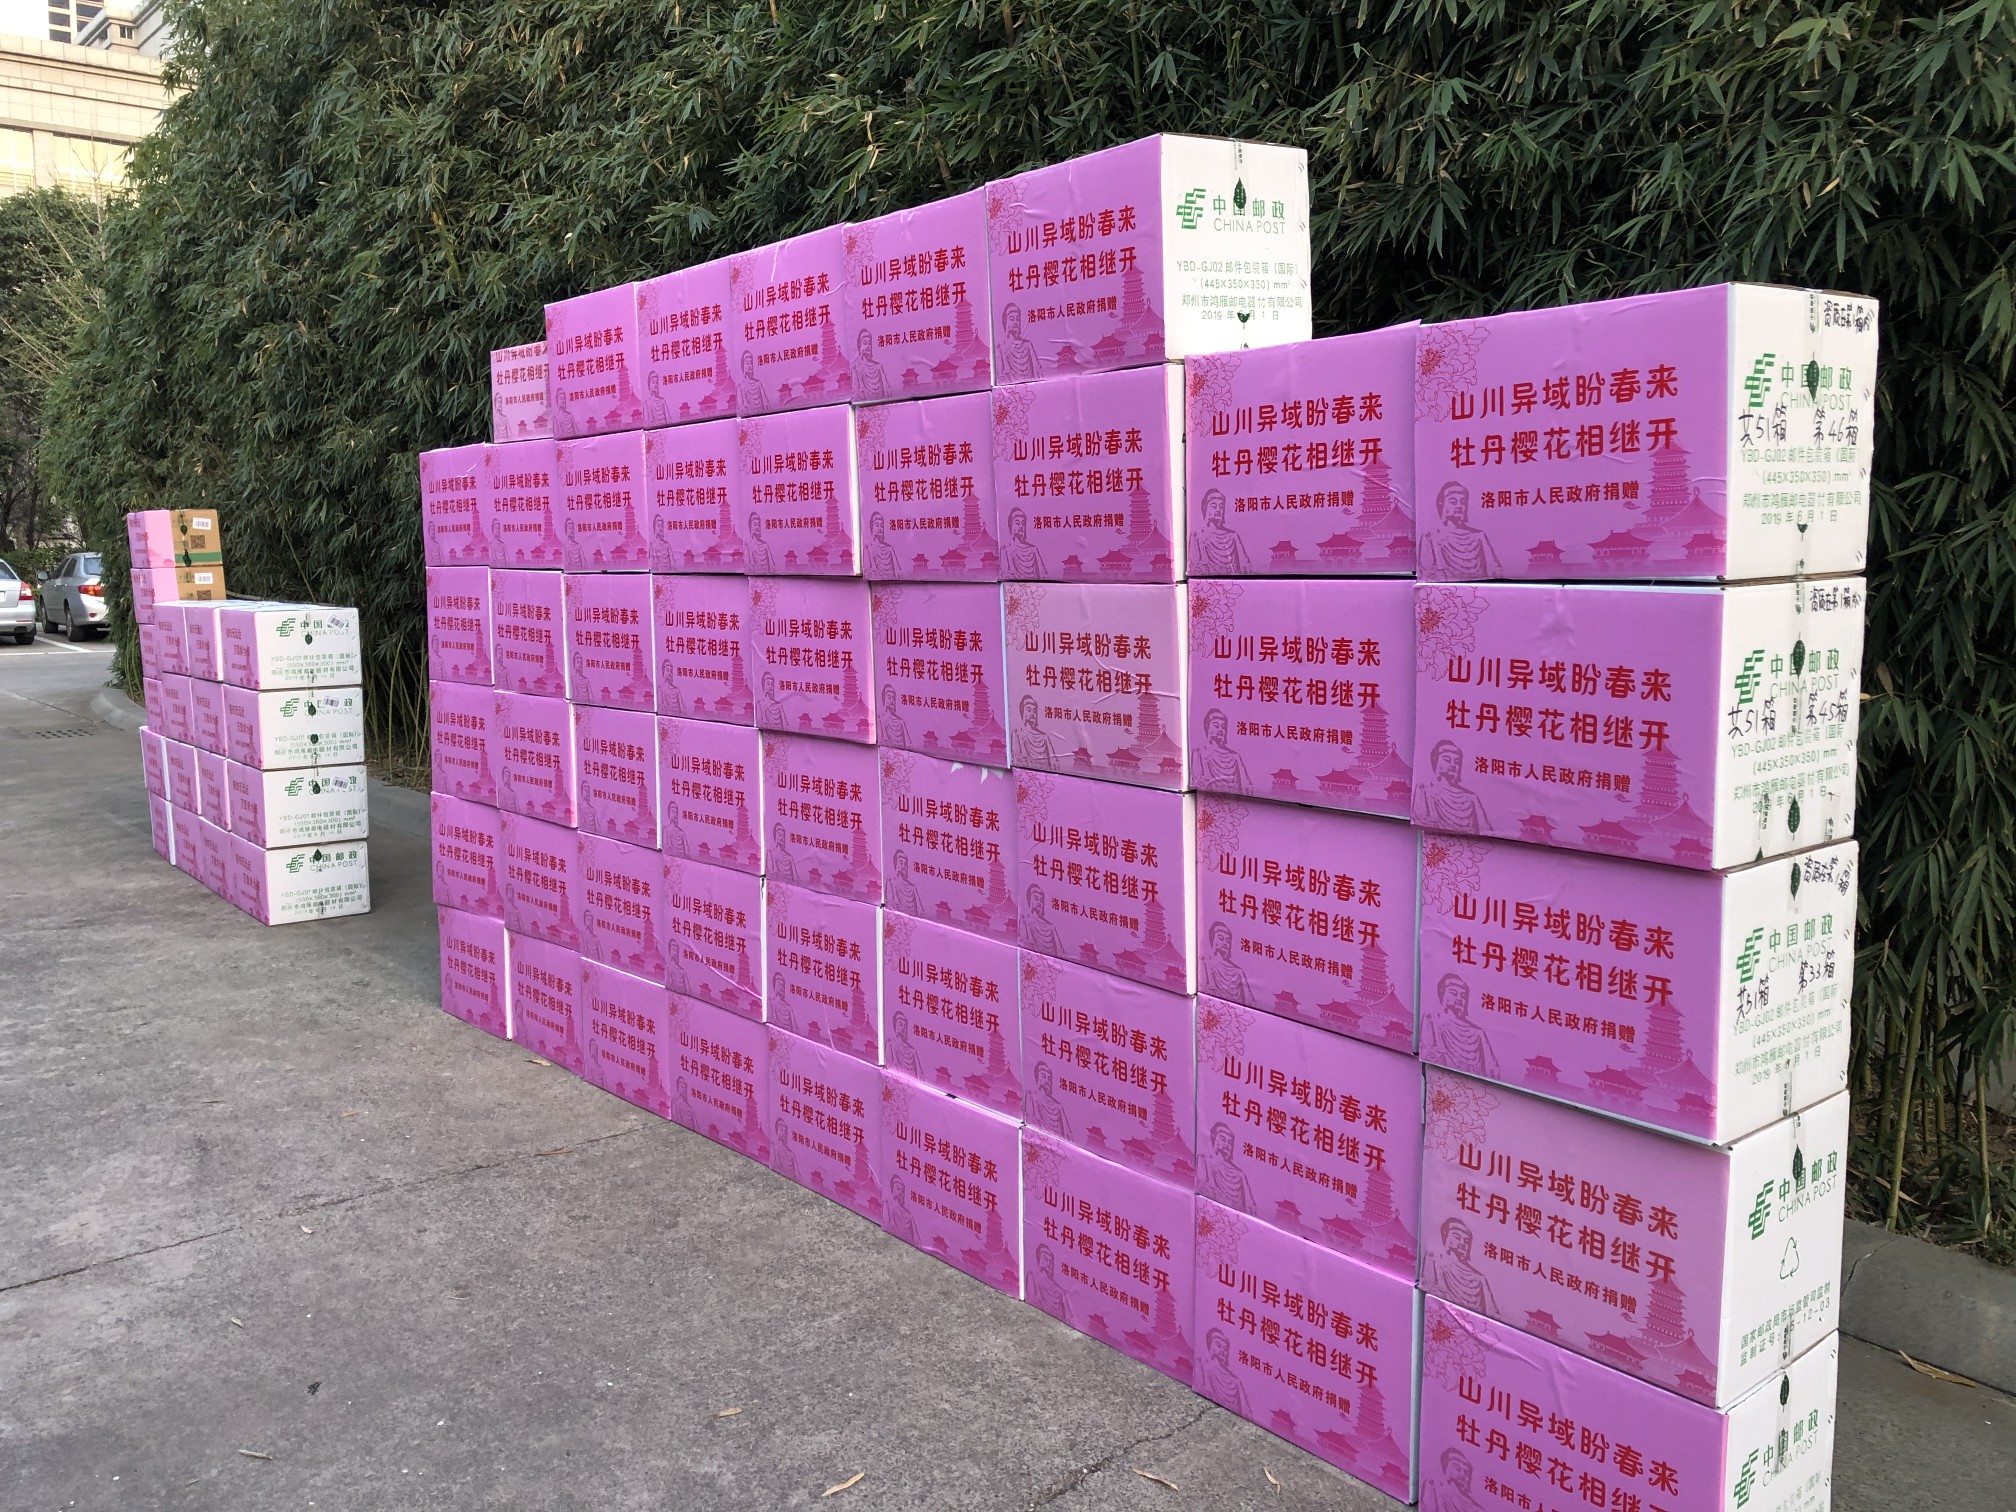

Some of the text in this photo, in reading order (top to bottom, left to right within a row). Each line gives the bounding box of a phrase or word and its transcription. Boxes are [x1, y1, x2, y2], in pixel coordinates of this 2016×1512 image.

[1008, 205, 1135, 254] 山川异域盼春来
[1214, 218, 1285, 234] CHINA POST
[861, 245, 965, 285] 山川异域盼春来
[1009, 245, 1136, 291] 牡丹樱花相继开
[1177, 261, 1222, 272] YBD-GJ02
[743, 271, 829, 311] 山川异域盼春来
[862, 281, 966, 319] 牡丹樱花相继开
[1027, 295, 1116, 323] 洛阳市人民政府捐赠
[650, 303, 721, 335] 山川异域盼春来
[744, 303, 830, 341] 牡丹樱花相继开
[556, 326, 623, 355] 山川异域盼春来
[651, 332, 722, 362] 牡丹樱花相继开
[1452, 364, 1677, 420] 山川异域盼春来
[1781, 392, 1852, 410] CHINA POST
[1212, 391, 1382, 435] 山川异域盼春来
[751, 449, 833, 474] 山川异域盼春来
[873, 441, 972, 470] 山川异域盼春来
[1014, 427, 1142, 460] 山川异域盼春来
[1212, 437, 1382, 477] 牡丹樱花相继开
[1451, 417, 1677, 468] 牡丹樱花相继开
[566, 464, 629, 486] 山川异域盼春来
[656, 458, 725, 480] 山川异域盼春来
[1015, 467, 1143, 497] 牡丹樱花相继开
[752, 480, 834, 503] 牡丹樱花相继开
[875, 476, 973, 502] 牡丹樱花相继开
[1234, 490, 1354, 512] 洛阳市人民政府捐赠
[1481, 479, 1639, 508] 洛阳市人民政府捐赠
[765, 516, 822, 529] 洛阳市人民政府捐赠
[889, 516, 959, 530] 洛阳市人民政府捐赠
[1033, 512, 1124, 529] 洛阳市人民政府捐赠
[665, 610, 739, 630] 山川异域盼春来
[765, 618, 852, 639] 山川异域盼春来
[886, 626, 982, 651] 山川异域盼春来
[766, 646, 852, 668] 牡丹樱花相继开
[1025, 631, 1150, 659] 山川异域盼春来
[1215, 635, 1380, 666] 山川异域盼春来
[779, 680, 839, 695] 洛阳市人民政府捐赠
[887, 656, 983, 683] 牡丹樱花相继开
[1026, 664, 1151, 695] 牡丹樱花相继开
[1449, 655, 1671, 702] 山川异域盼春来
[1771, 674, 1839, 699] CHINA POST
[901, 694, 969, 712] 洛阳市人民政府捐赠
[1214, 673, 1380, 708] 牡丹樱花相继开
[1044, 706, 1132, 727] 洛阳市人民政府捐赠
[1236, 721, 1352, 745] 洛阳市人民政府捐赠
[1446, 699, 1669, 750] 牡丹樱花相继开
[671, 753, 744, 781] 山川异域盼春来
[1474, 757, 1630, 792] 洛阳市人民政府捐赠
[778, 771, 861, 802] 山川异域盼春来
[778, 798, 861, 830] 牡丹樱花相继开
[898, 794, 999, 831] 山川异域盼春来
[790, 833, 848, 854] 洛阳市人民政府捐赠
[899, 823, 999, 862] 牡丹樱花相继开
[1033, 822, 1157, 868] 山川异域盼春来
[338, 860, 357, 868] POST
[913, 861, 984, 889] 洛阳市人民政府捐赠
[1033, 854, 1158, 902] 牡丹樱花相继开
[1220, 852, 1380, 908] 山川异域盼春来
[672, 892, 745, 928] 山川异域盼春来
[1051, 898, 1138, 931] 洛阳市人民政府捐赠
[1219, 888, 1380, 947] 牡丹樱花相继开
[1455, 892, 1674, 960] 山川异域盼春来
[777, 921, 860, 961] 山川异域盼春来
[1769, 913, 1832, 953] 中国邮政
[778, 948, 860, 989] 牡丹樱花相继开
[1240, 938, 1352, 979] 洛阳市人民政府捐赠
[1452, 935, 1673, 1006] 牡丹樱花相继开
[1769, 937, 1832, 972] CHINA POST
[789, 984, 847, 1011] 洛阳市人民政府捐赠
[899, 956, 998, 1003] 山川异域盼春来
[899, 985, 999, 1033] 牡丹樱花相继开
[1481, 994, 1635, 1043] 洛阳市人民政府捐赠
[913, 1024, 983, 1058] 洛阳市人民政府捐赠
[1041, 1001, 1167, 1061] 山川异域盼春来
[680, 1031, 753, 1074] 山川异域盼春来
[1041, 1033, 1167, 1095] 牡丹樱花相继开
[780, 1069, 863, 1118] 山川异域盼春来
[1059, 1078, 1147, 1121] 洛阳市人民政府捐赠
[1224, 1055, 1386, 1134] 山川异域盼春来
[780, 1094, 864, 1145] 牡丹樱花相继开
[1222, 1091, 1385, 1171] 牡丹樱花相继开
[792, 1131, 850, 1166] 洛阳市人民政府捐赠
[896, 1121, 997, 1183] 山川异域盼春来
[896, 1149, 997, 1212] 牡丹樱花相继开
[1243, 1142, 1357, 1199] 洛阳市人民政府捐赠
[1779, 1150, 1837, 1202] 中国邮政
[1459, 1143, 1678, 1241] 山川异域盼春来
[1779, 1174, 1837, 1222] CHINA POST
[910, 1191, 981, 1234] 洛阳市人民政府捐赠
[1044, 1186, 1169, 1260] 山川异域盼春来
[1456, 1182, 1676, 1283] 牡丹樱花相继开
[1044, 1217, 1169, 1293] 牡丹樱花相继开
[1061, 1263, 1149, 1316] 洛阳市人民政府捐赠
[1484, 1242, 1636, 1314] 洛阳市人民政府捐赠
[1219, 1263, 1377, 1352] 山川异域盼春来
[1217, 1297, 1377, 1389] 牡丹樱花相继开
[1238, 1350, 1350, 1415] 洛阳市人民政府捐赠
[1459, 1375, 1678, 1497] 山川异域盼春来
[1796, 1430, 1818, 1459] POST
[1456, 1414, 1676, 1511] 牡丹樱花相继
